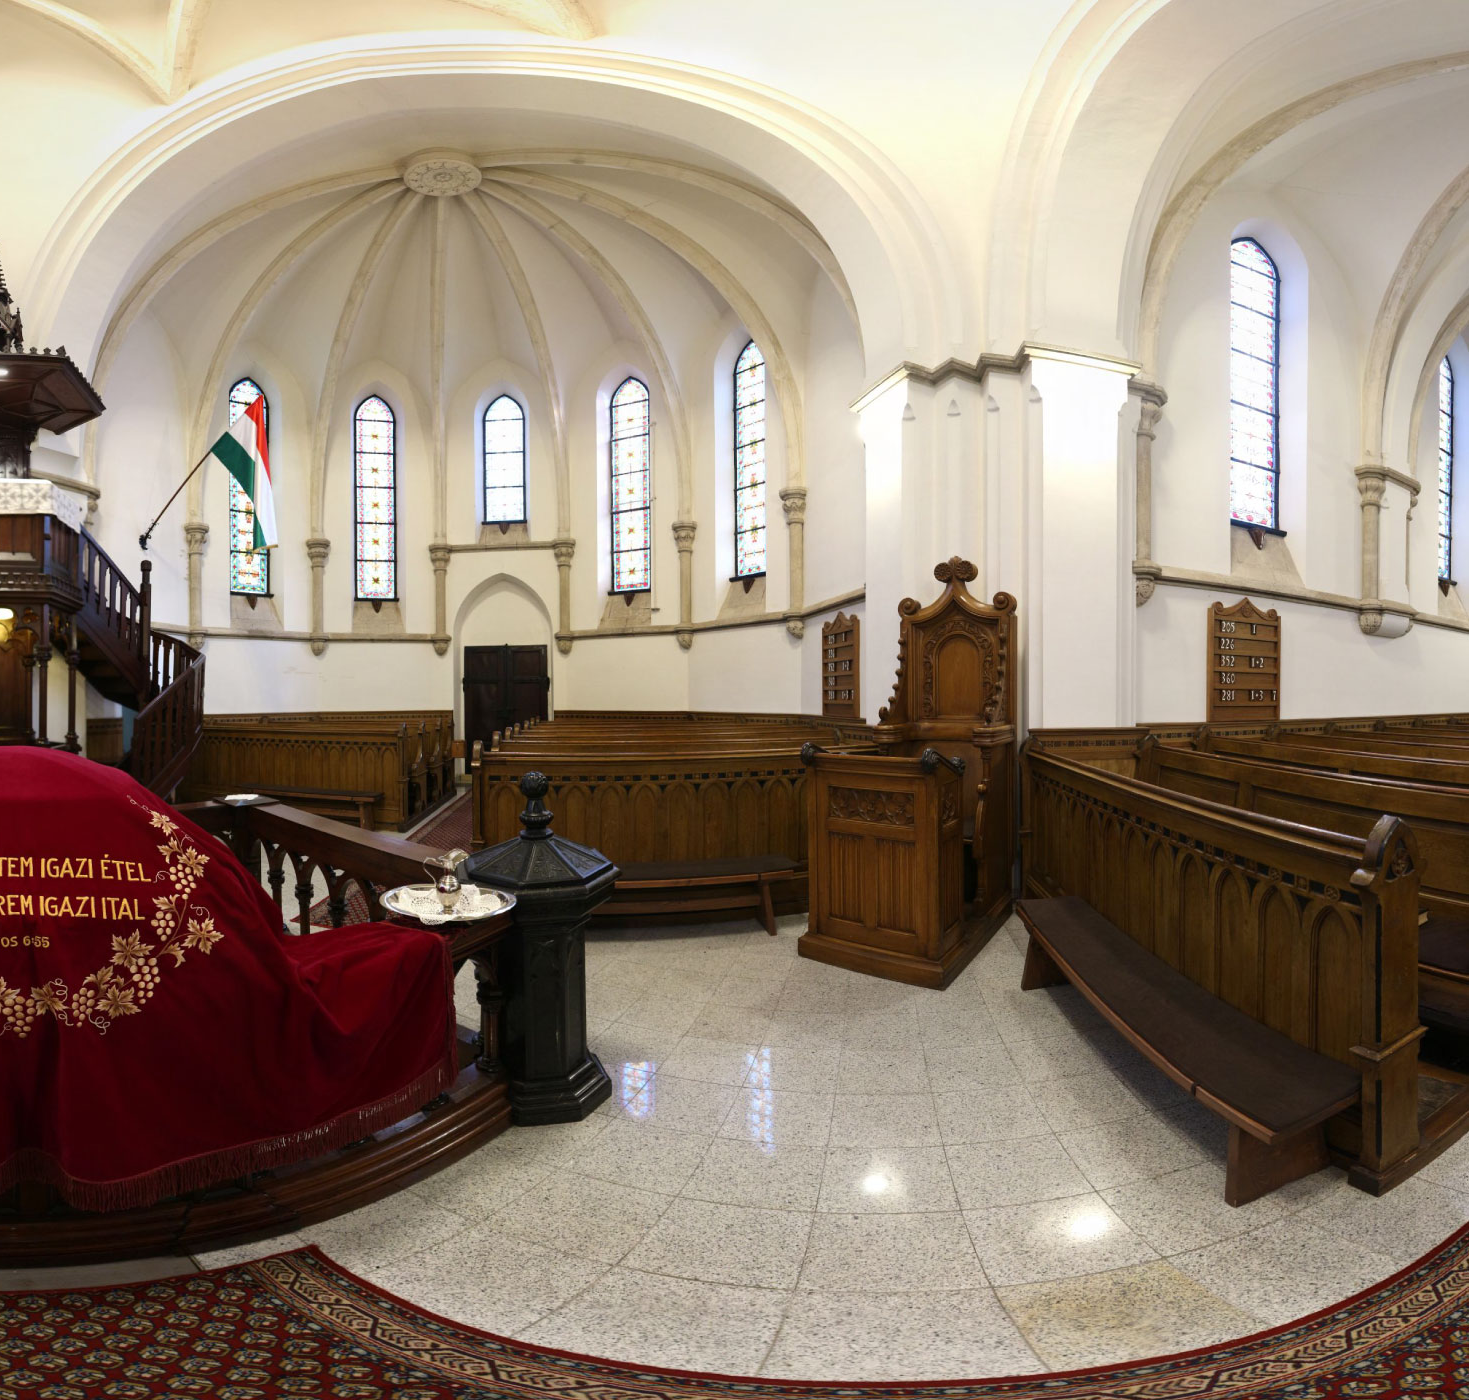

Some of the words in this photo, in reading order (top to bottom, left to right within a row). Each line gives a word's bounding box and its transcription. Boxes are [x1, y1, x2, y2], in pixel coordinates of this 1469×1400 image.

[1221, 621, 1236, 633] 205
[1220, 638, 1235, 650] 226
[1220, 655, 1235, 667] 352
[1221, 673, 1236, 684] 360
[1221, 690, 1235, 701] 281
[40, 857, 94, 879] IGAZI
[100, 854, 152, 882] ÉTEL
[39, 895, 96, 919] IGAZI
[102, 897, 146, 920] ITAL
[23, 935, 50, 948] 6:55
